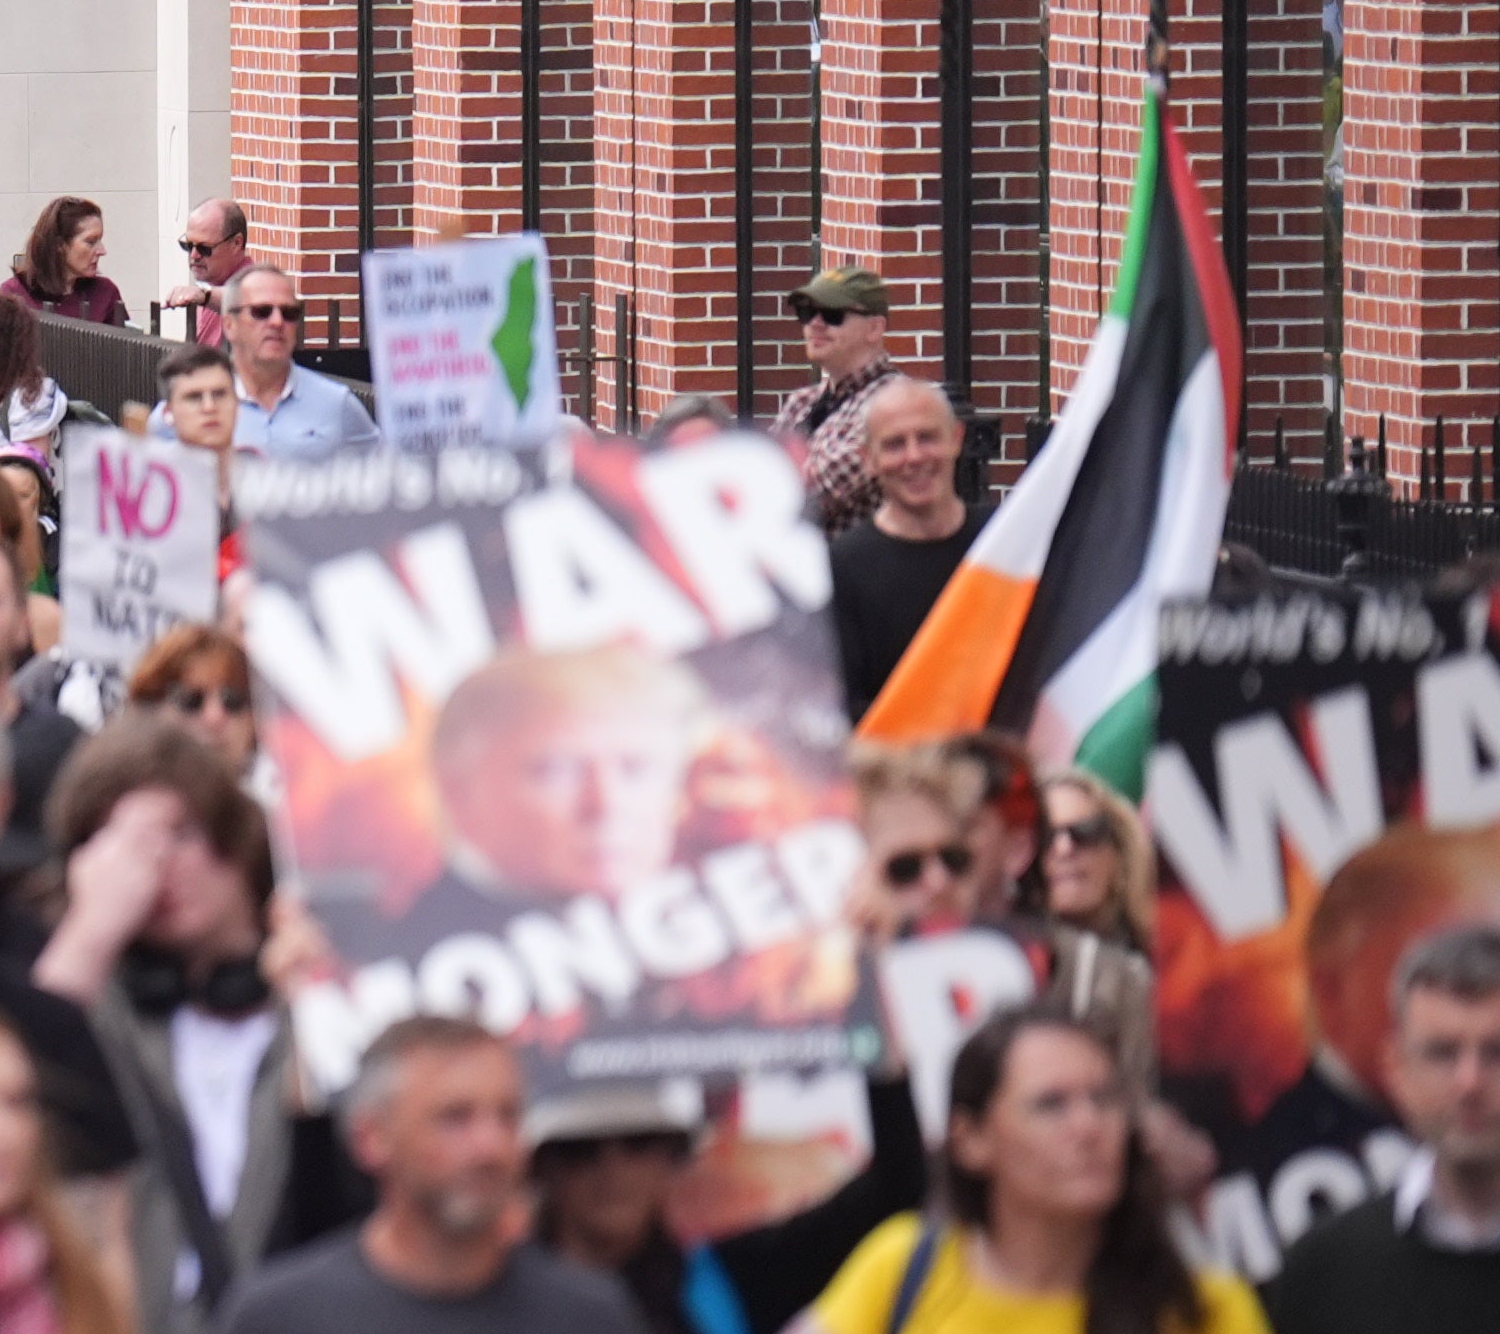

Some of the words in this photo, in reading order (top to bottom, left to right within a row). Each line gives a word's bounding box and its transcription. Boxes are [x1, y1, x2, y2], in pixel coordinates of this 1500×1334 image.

[95, 445, 179, 541] NO
[236, 452, 432, 518] World's
[246, 429, 834, 761] WAR
[1156, 591, 1347, 667] World's
